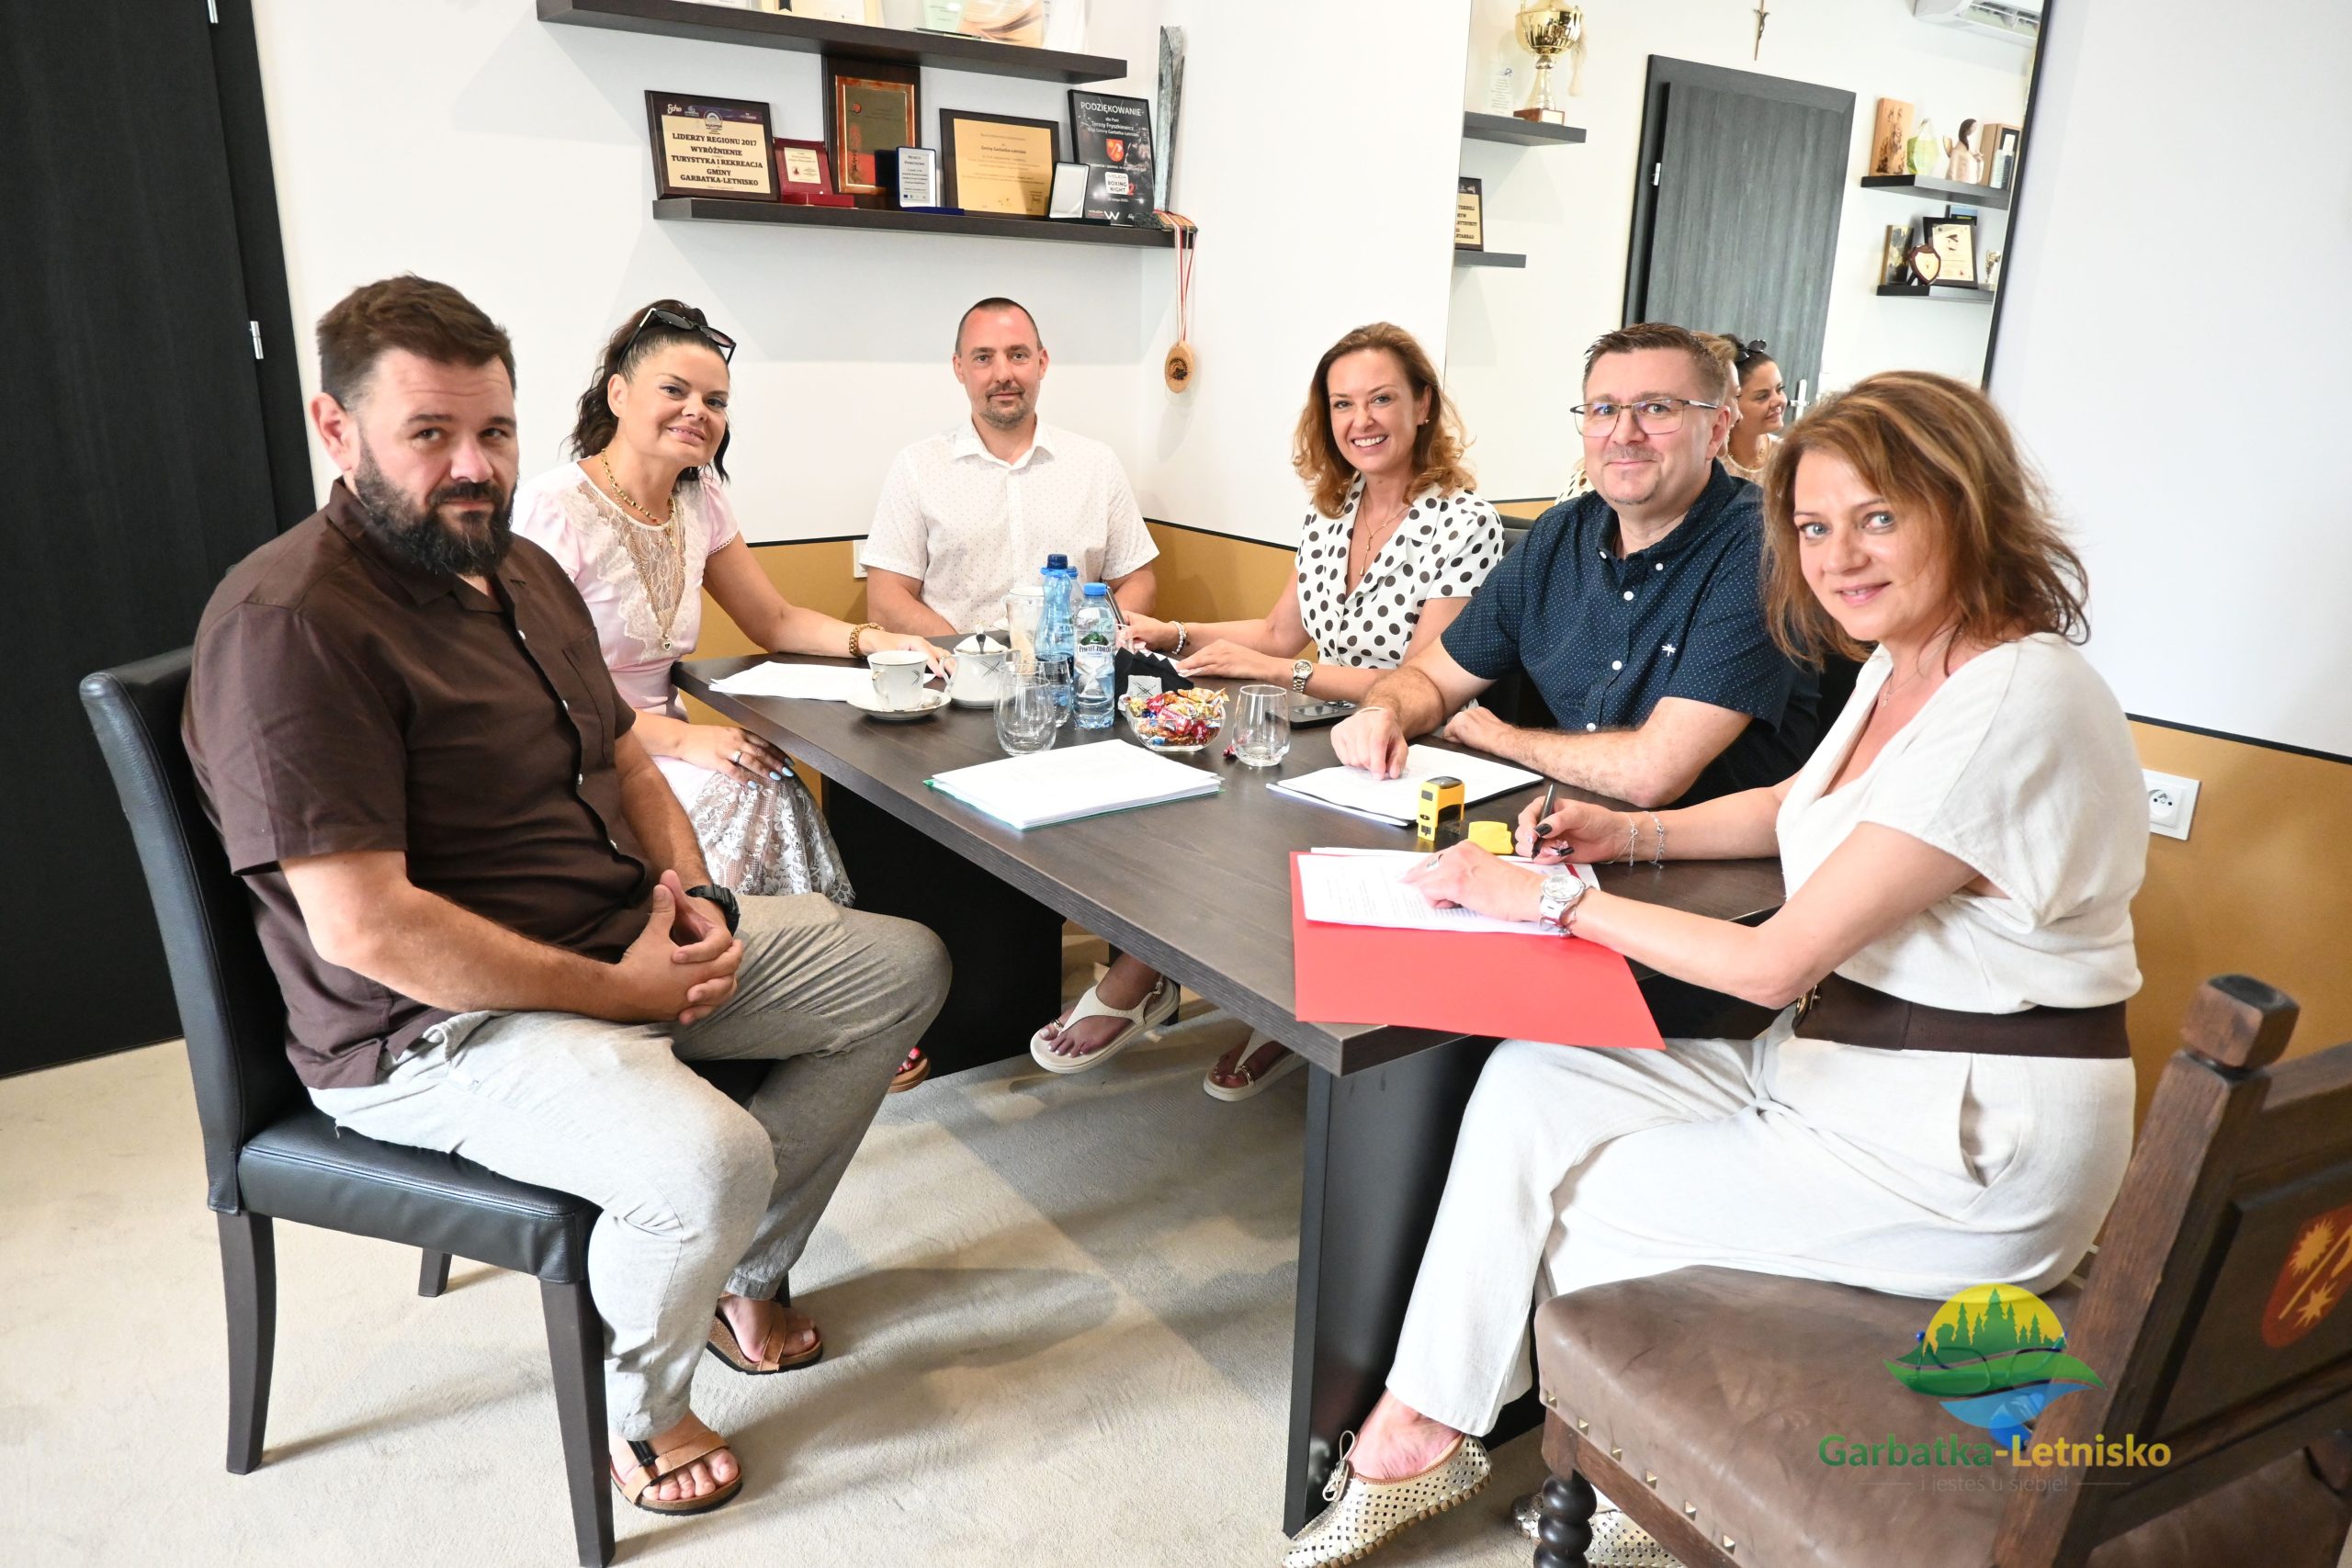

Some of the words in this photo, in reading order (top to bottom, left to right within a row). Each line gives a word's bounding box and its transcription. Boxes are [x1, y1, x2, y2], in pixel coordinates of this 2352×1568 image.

[1080, 101, 1142, 117] PODZIĘKOWANIE
[672, 132, 706, 142] LIDERZY
[707, 135, 741, 145] REGIONU
[741, 139, 757, 147] 2017
[690, 145, 743, 156] WYRÓŻNIENIE
[671, 154, 716, 165] TURYSTYKA
[720, 159, 763, 169] REKREACJA
[707, 168, 731, 176] GMINY
[680, 174, 759, 186] GARBATKA-LETNISKO
